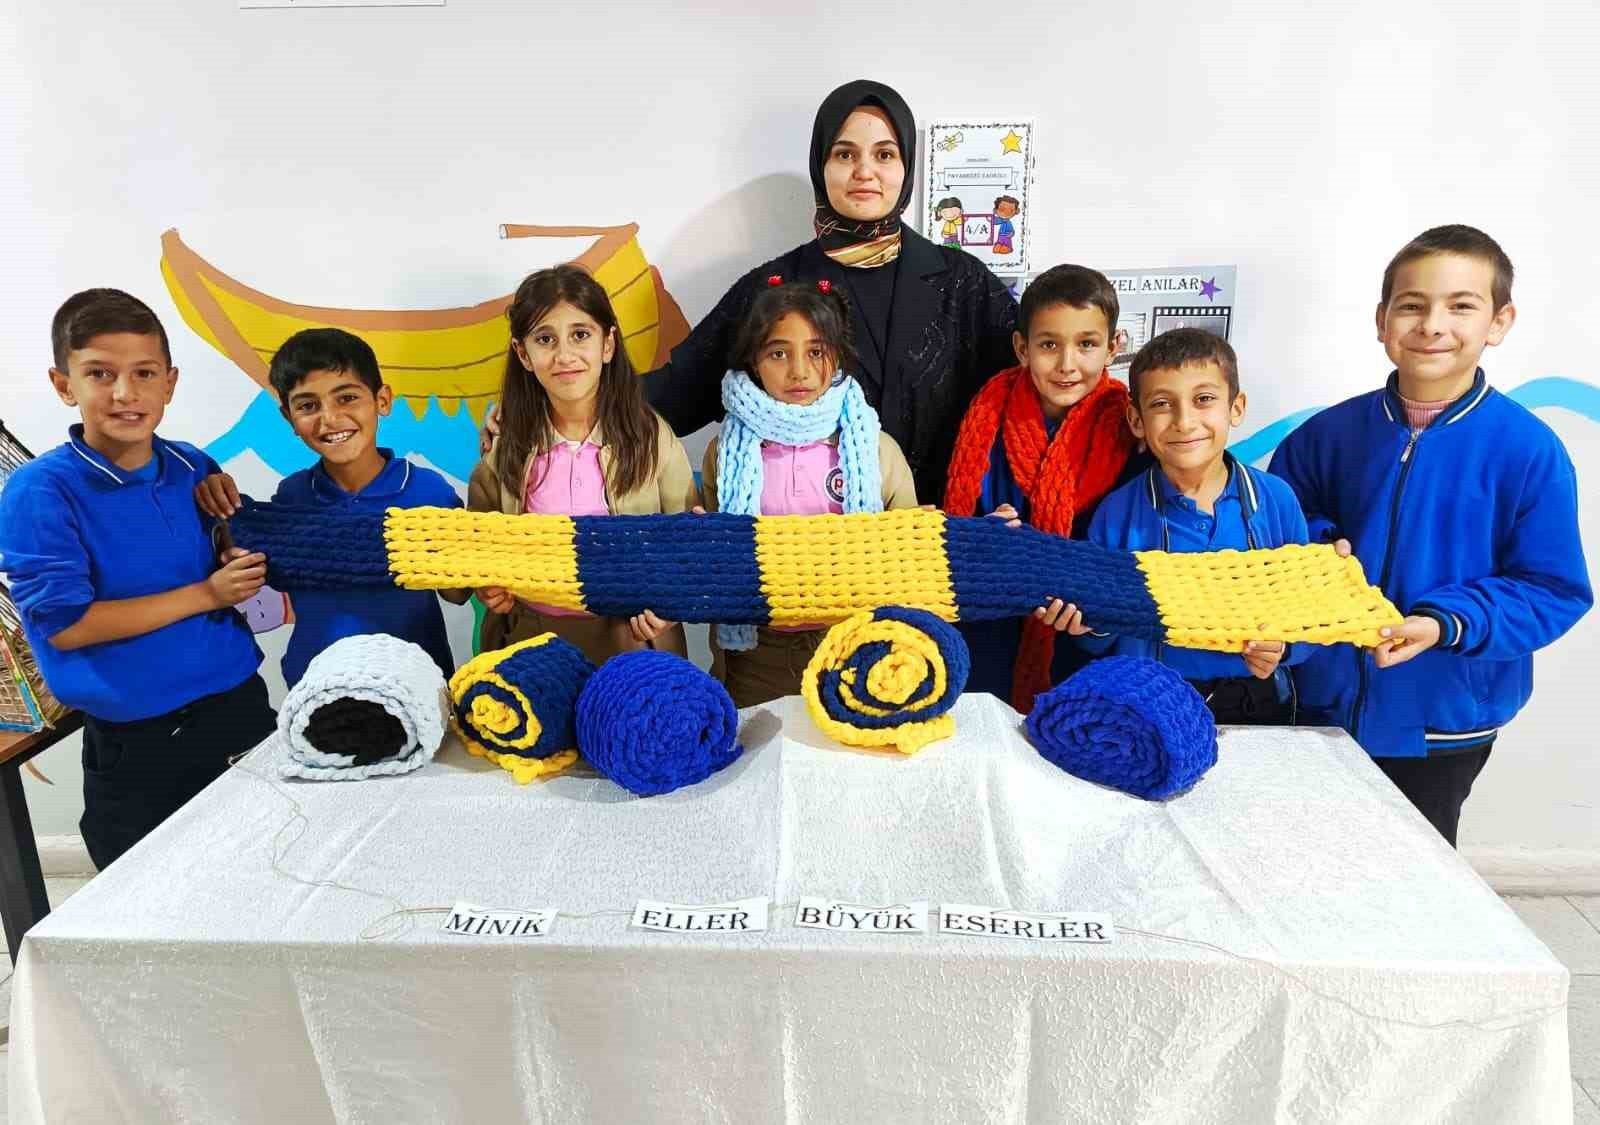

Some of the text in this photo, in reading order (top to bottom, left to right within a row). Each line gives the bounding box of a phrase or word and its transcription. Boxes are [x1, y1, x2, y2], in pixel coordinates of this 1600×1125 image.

[1141, 276, 1200, 291] ANILAR
[445, 905, 1106, 940] MİNİK ELLER BÜYÜK ESERLER
